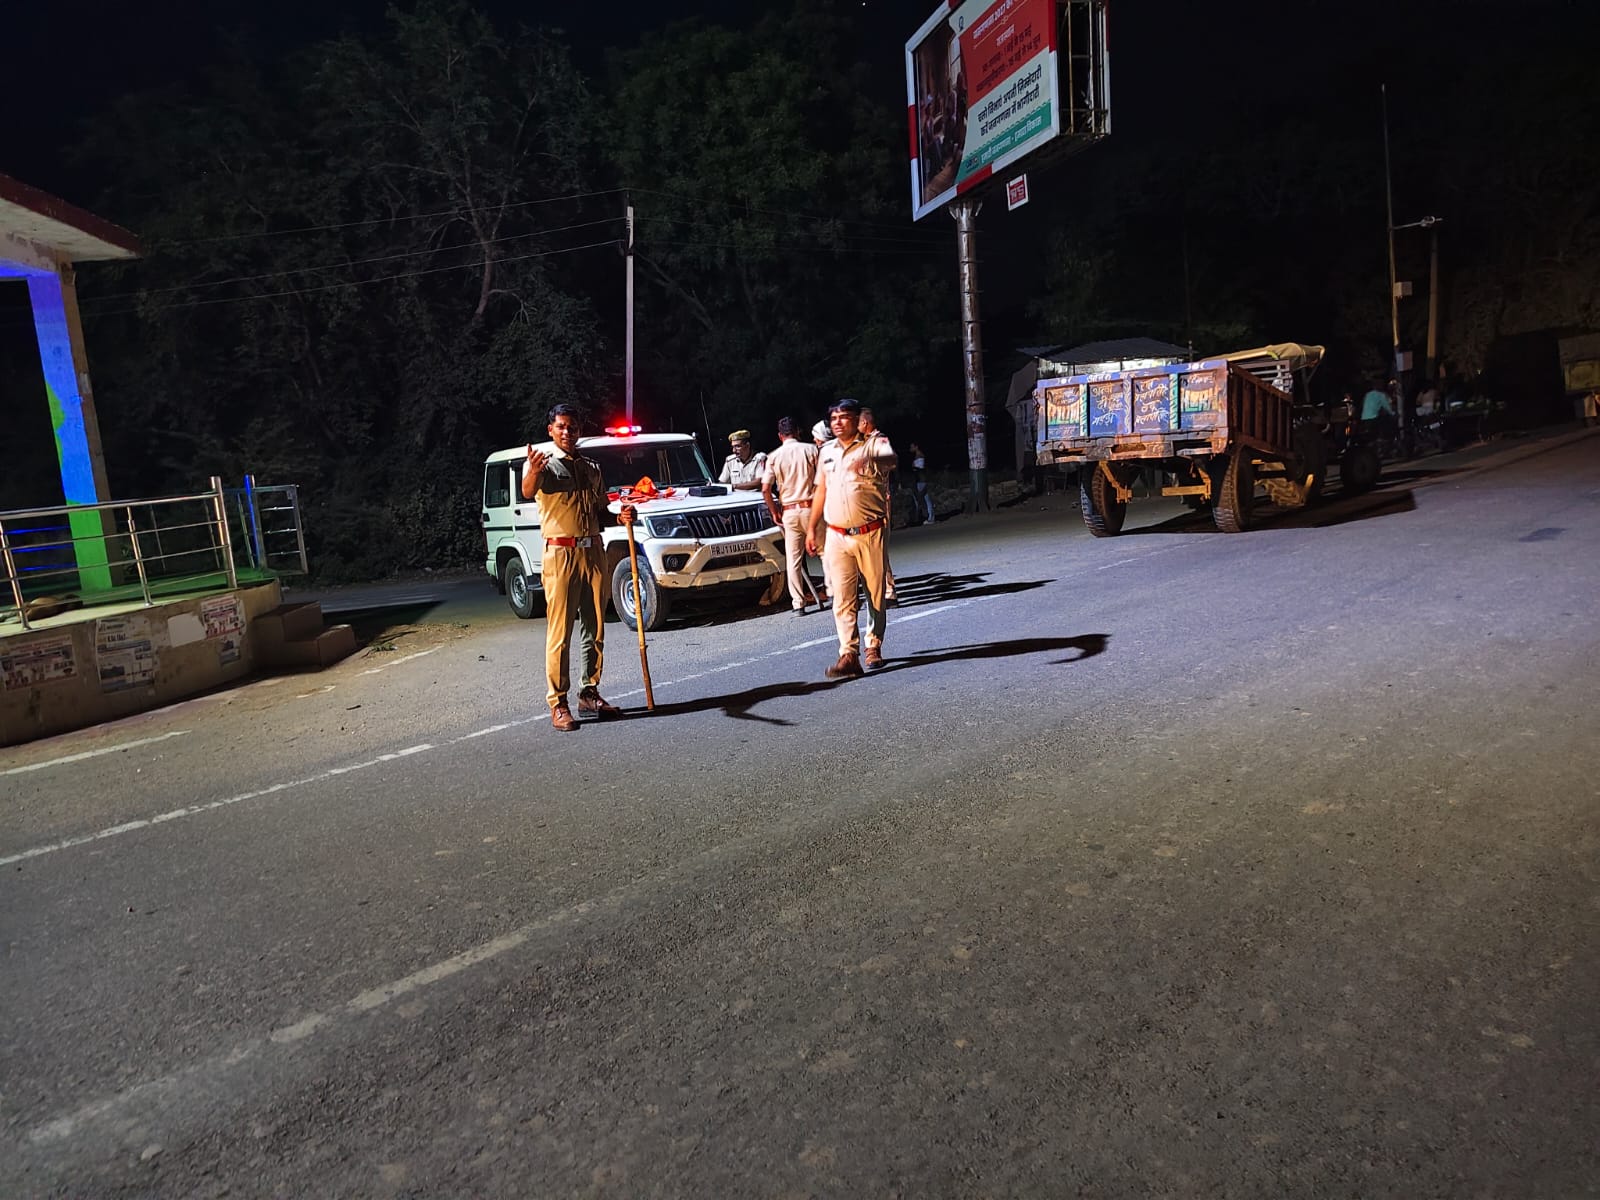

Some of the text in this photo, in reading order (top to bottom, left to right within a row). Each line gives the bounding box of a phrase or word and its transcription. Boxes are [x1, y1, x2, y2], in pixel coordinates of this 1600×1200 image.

[977, 106, 988, 122] चलो
[1003, 83, 1017, 104] अपनी
[980, 121, 989, 137] करें
[988, 107, 1011, 130] जनगणना
[1017, 84, 1040, 111] भागीदारी
